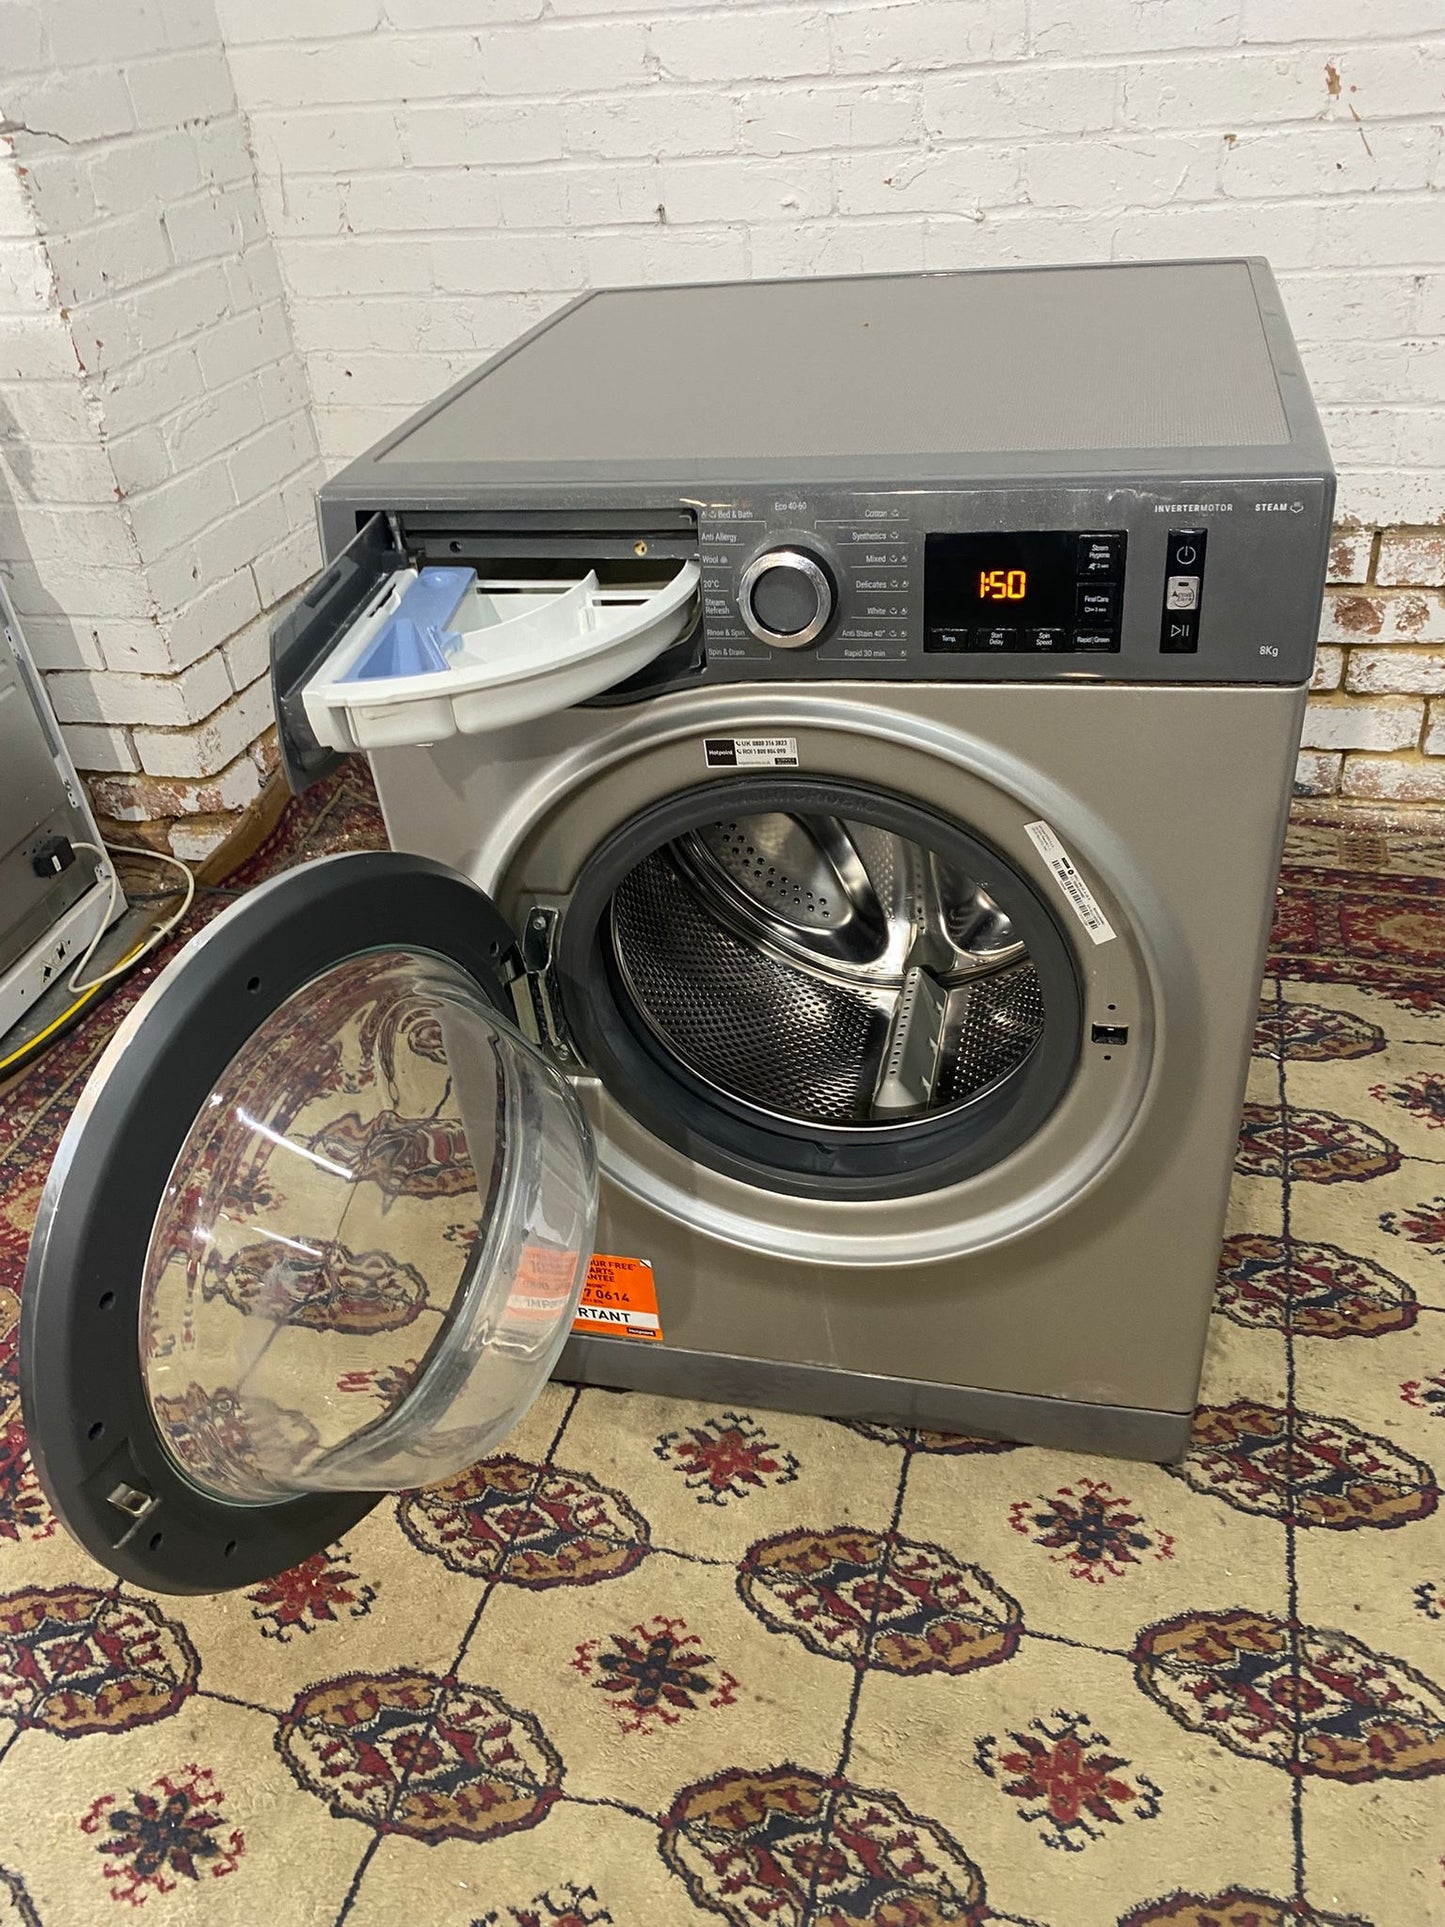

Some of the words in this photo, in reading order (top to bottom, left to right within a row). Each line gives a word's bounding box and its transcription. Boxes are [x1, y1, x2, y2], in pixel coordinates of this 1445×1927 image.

[775, 502, 788, 511] Eco
[789, 502, 807, 510] 40-60
[1155, 502, 1233, 512] INVERTERMOTOR
[1255, 503, 1287, 511] STEAM
[718, 510, 729, 519] Bed
[738, 510, 753, 519] Bath
[702, 533, 714, 541] Anti
[716, 533, 737, 542] Allergy
[852, 532, 886, 540] Synthetics
[702, 556, 719, 564] Wool
[866, 555, 886, 563] Mixed
[856, 580, 886, 589] Delicates
[980, 571, 1026, 599] 1:50
[705, 599, 725, 607] Steam
[867, 607, 886, 615] White
[707, 629, 723, 637] Rinse
[725, 629, 730, 637] &
[731, 629, 745, 638] Spin
[708, 649, 721, 657] Spin
[845, 649, 862, 658] Rapid
[864, 649, 872, 657] 30
[873, 649, 886, 657] min
[1259, 646, 1279, 657] 8Kg
[596, 1290, 629, 1302] 0614
[578, 1308, 630, 1322] RTANT
